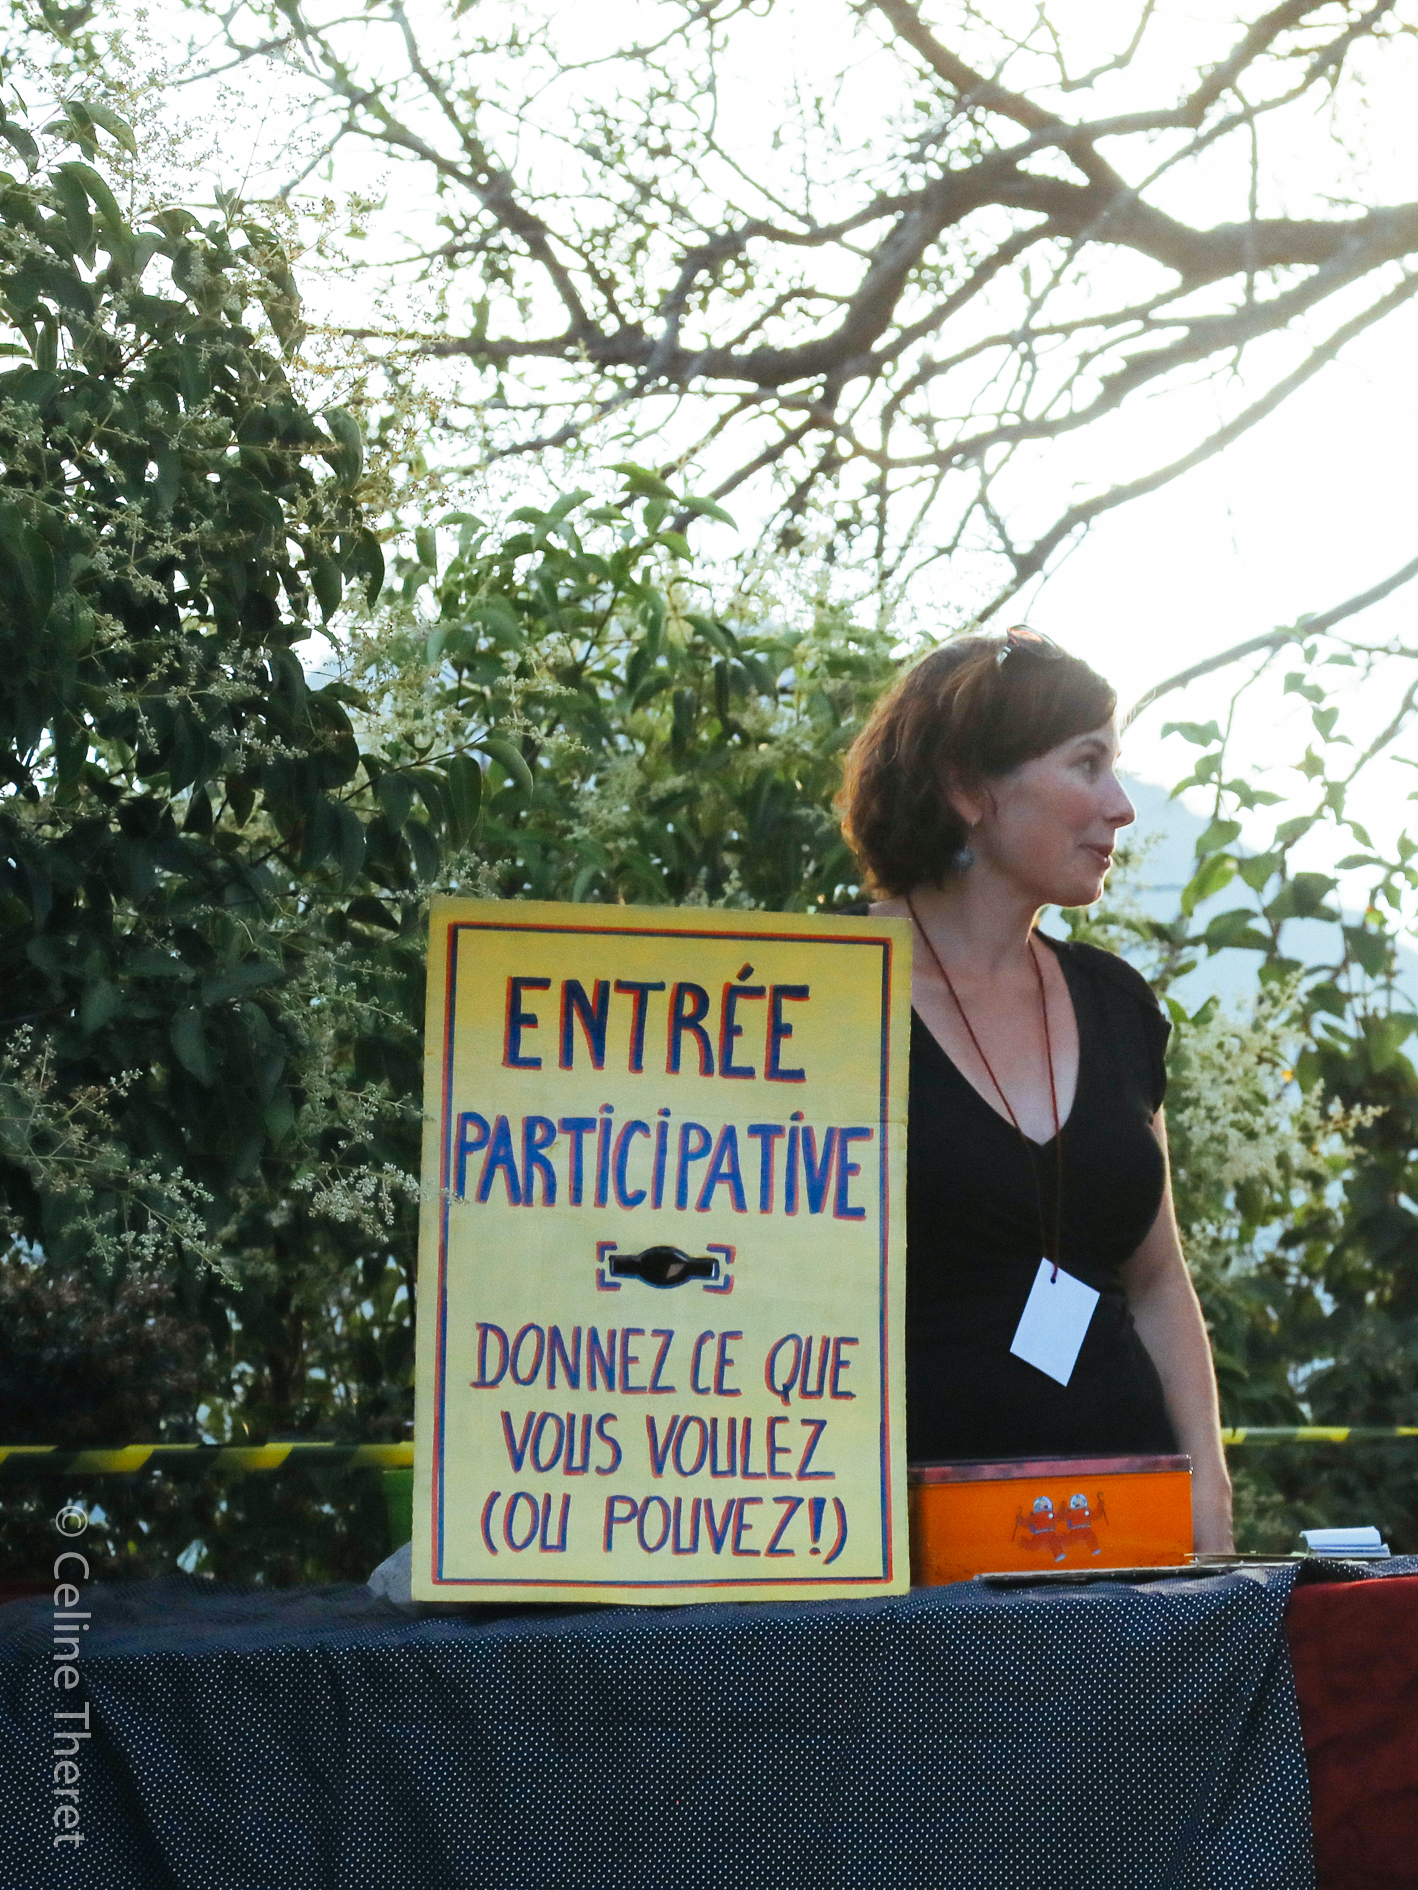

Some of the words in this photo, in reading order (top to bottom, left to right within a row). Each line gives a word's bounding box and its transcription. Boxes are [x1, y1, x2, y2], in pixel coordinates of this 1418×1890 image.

[502, 963, 810, 1083] ENTRÉE
[454, 1103, 874, 1221] PARTICIPATIVE
[470, 1322, 676, 1395] DONNEZ
[690, 1330, 743, 1397] CE
[765, 1334, 860, 1406] QUE
[501, 1410, 623, 1475] VOUS
[646, 1414, 836, 1481] VOULEZ
[480, 1491, 571, 1556] (OU
[603, 1495, 849, 1565] POUVEZ!)
